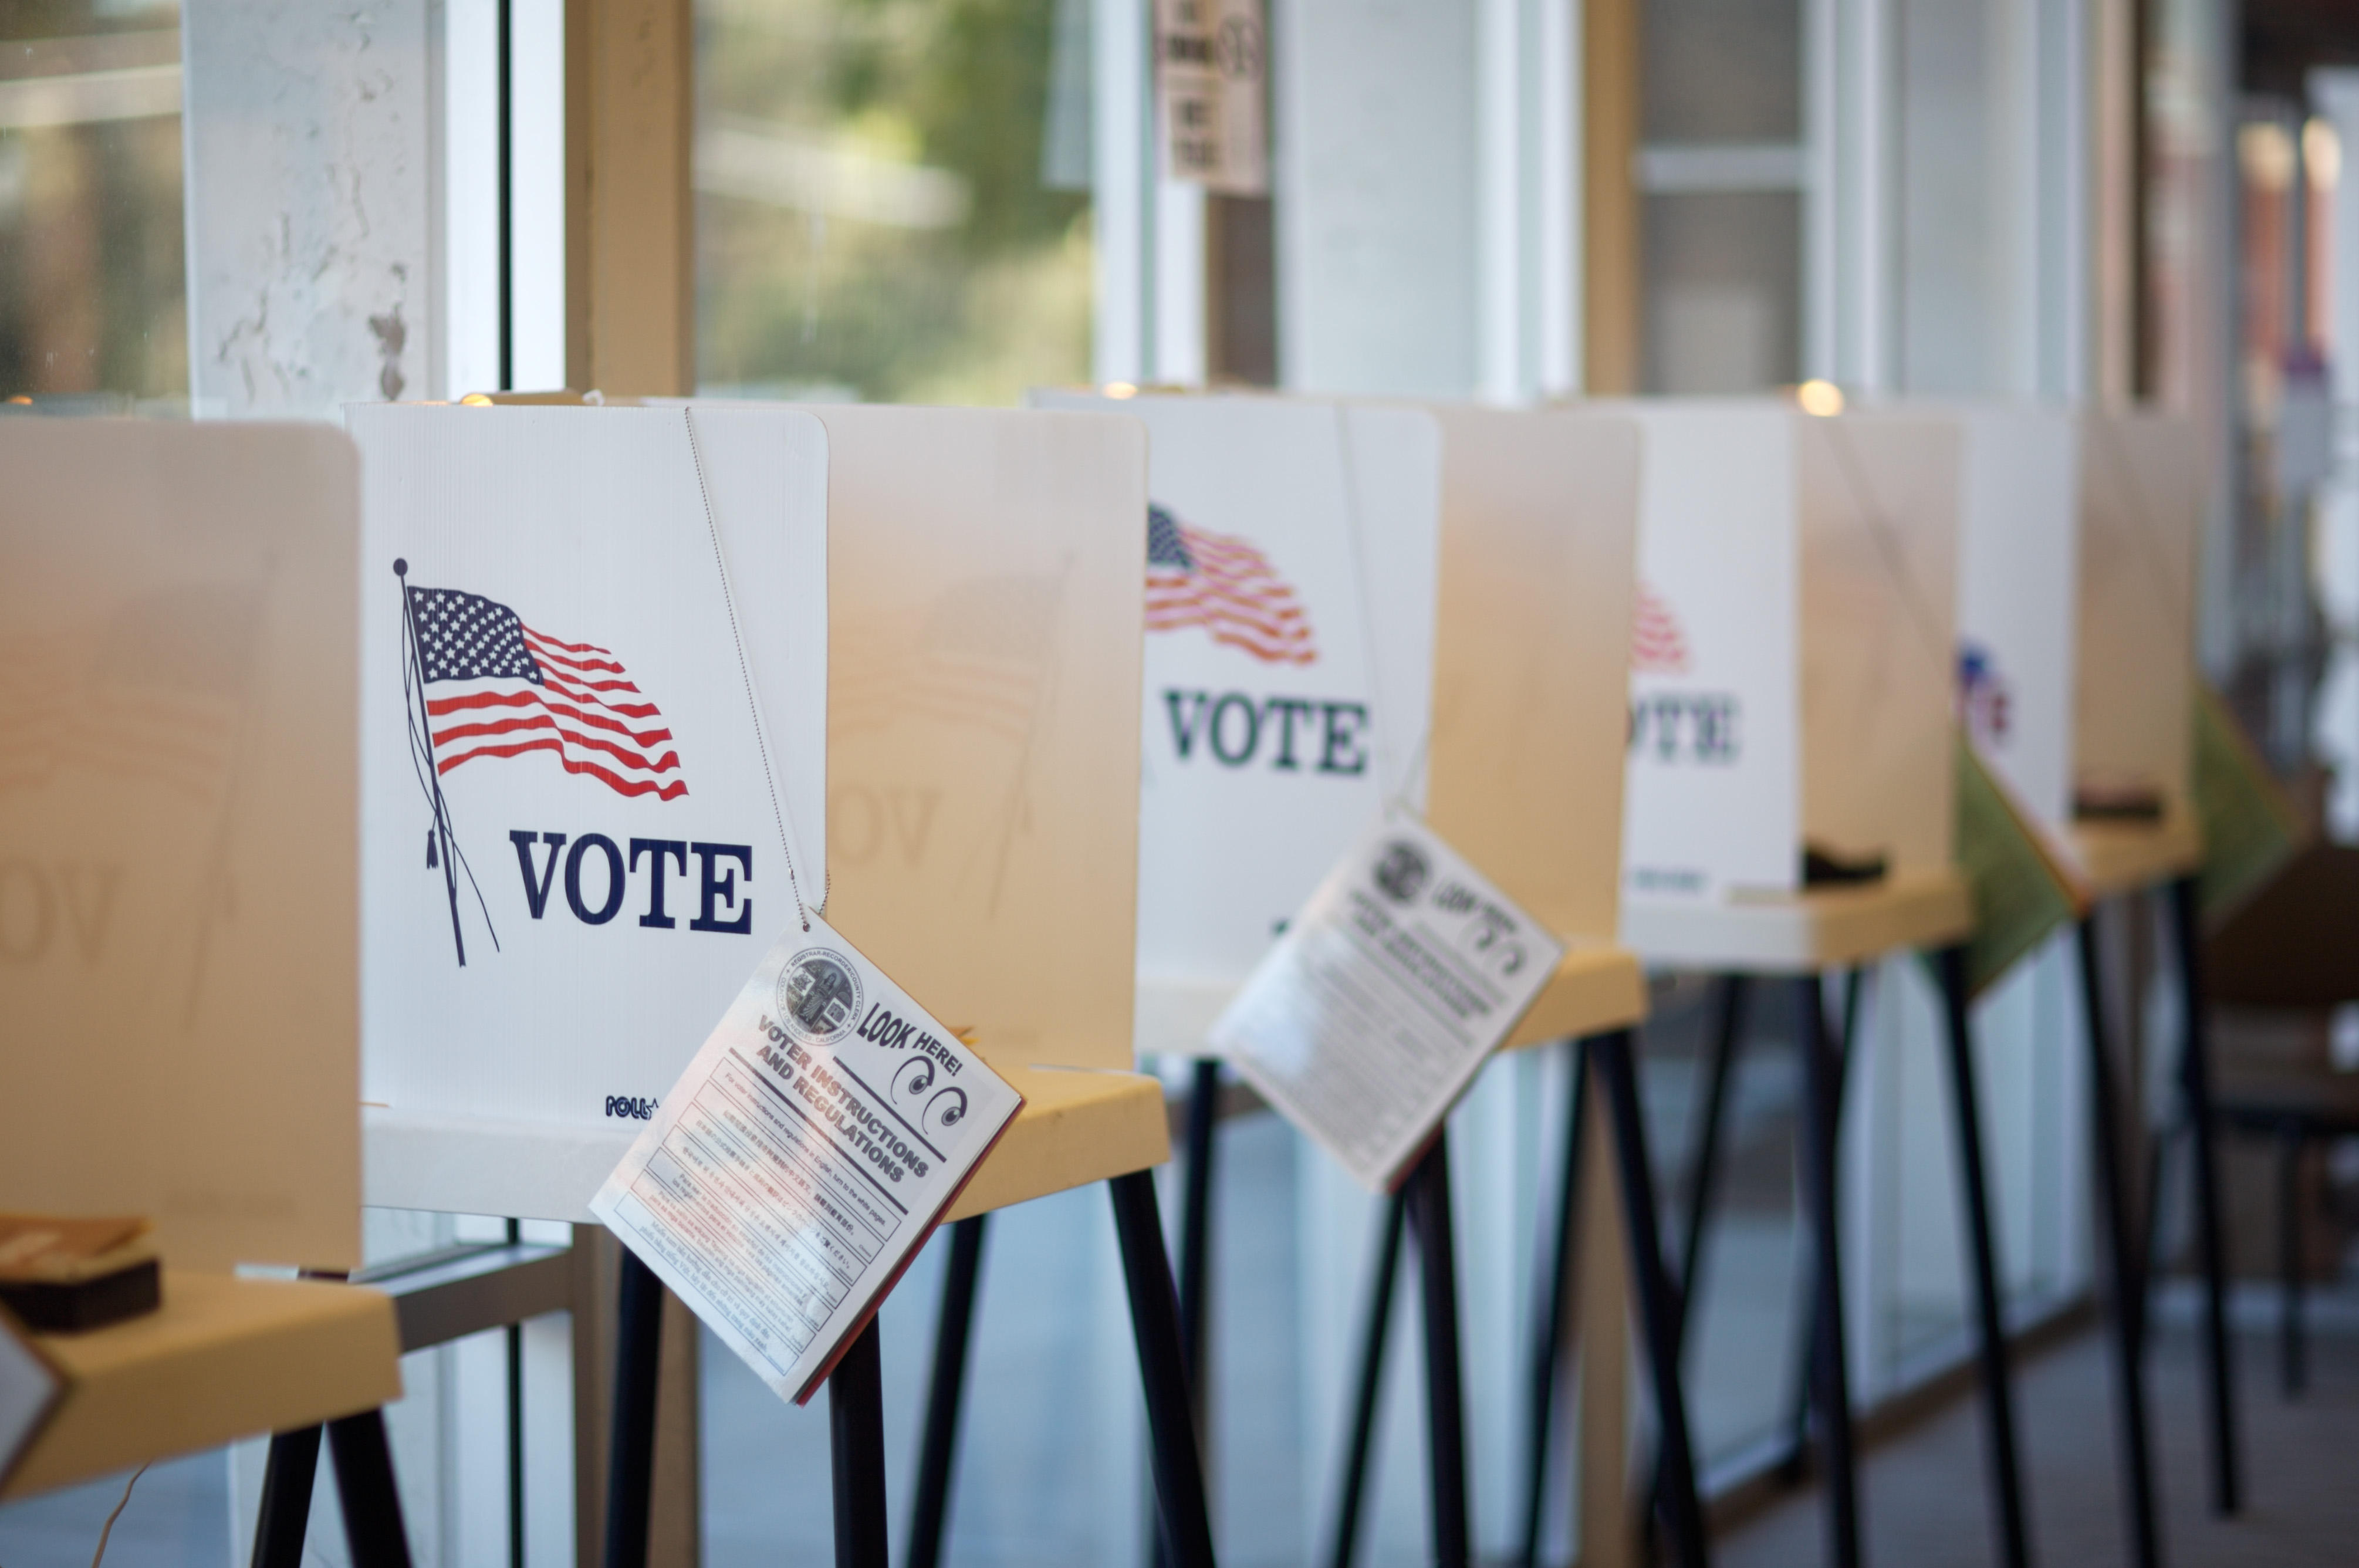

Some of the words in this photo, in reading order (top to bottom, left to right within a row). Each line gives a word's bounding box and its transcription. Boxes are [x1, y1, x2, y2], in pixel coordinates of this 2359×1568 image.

[1163, 688, 1368, 776] VOTE
[509, 829, 753, 935] VOTE
[850, 1001, 860, 1022] CLERK
[856, 1001, 917, 1049] LOOK
[911, 1031, 963, 1077] HERE!
[755, 1045, 794, 1080] AND
[792, 1075, 904, 1182] REGULATIONS
[758, 1013, 812, 1070] VOTER
[810, 1064, 929, 1178] INSTRUCTIONS
